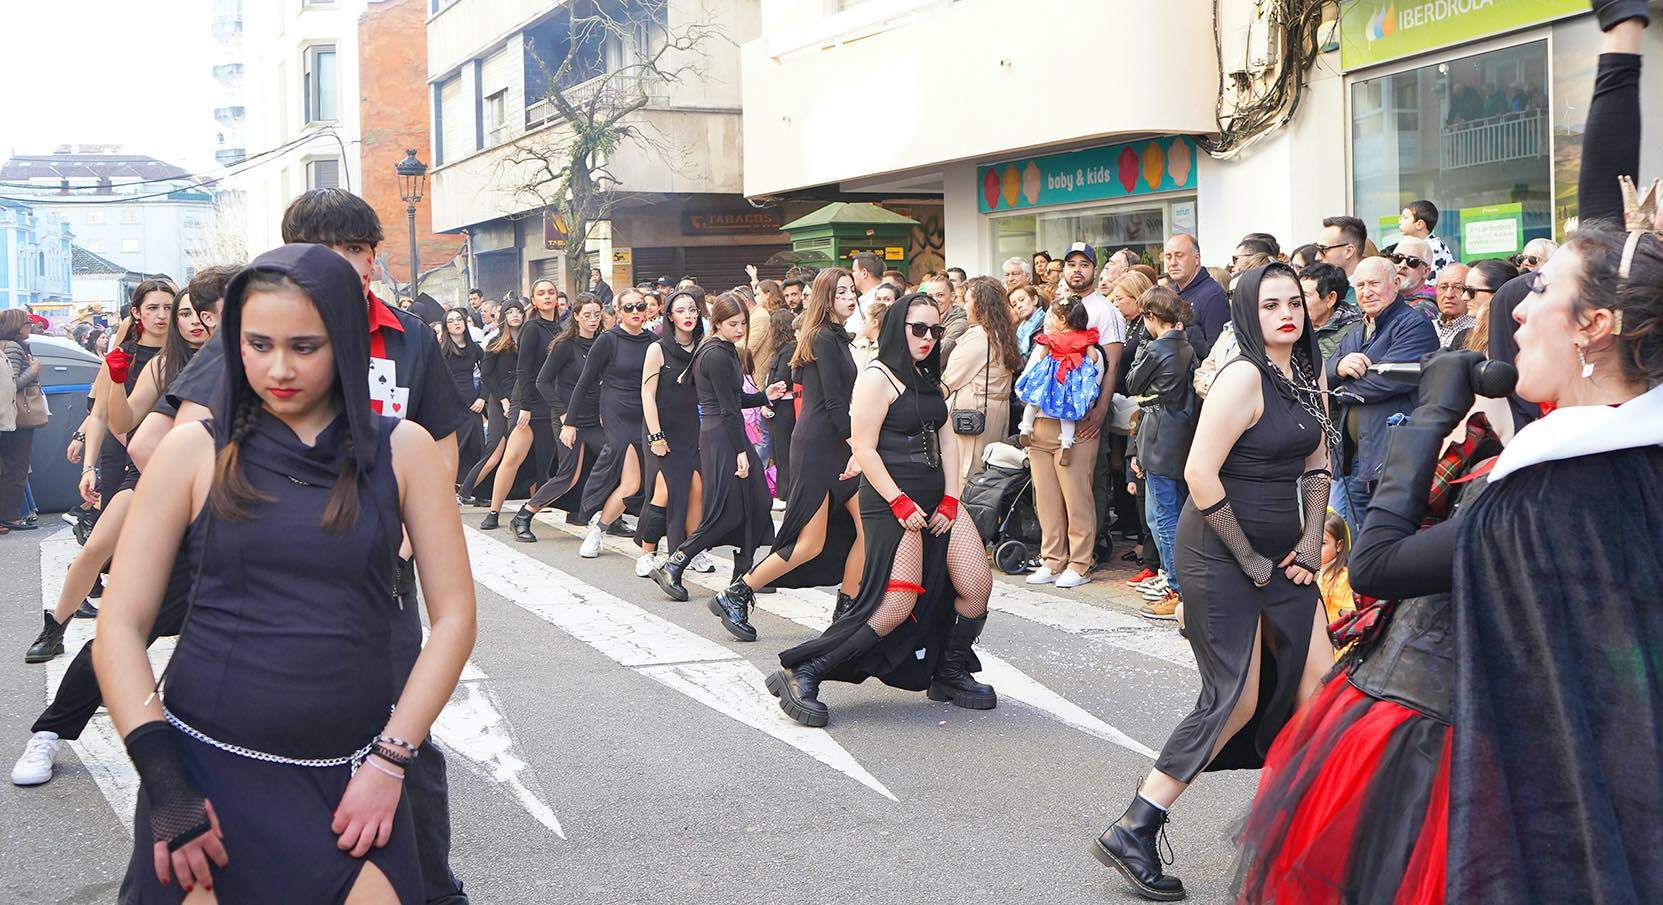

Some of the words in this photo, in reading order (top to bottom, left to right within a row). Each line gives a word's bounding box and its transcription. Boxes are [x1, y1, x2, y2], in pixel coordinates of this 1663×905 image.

[1048, 172, 1073, 192] baby
[1076, 169, 1085, 187] &
[1087, 165, 1111, 185] kids
[708, 213, 773, 225] TABACOS
